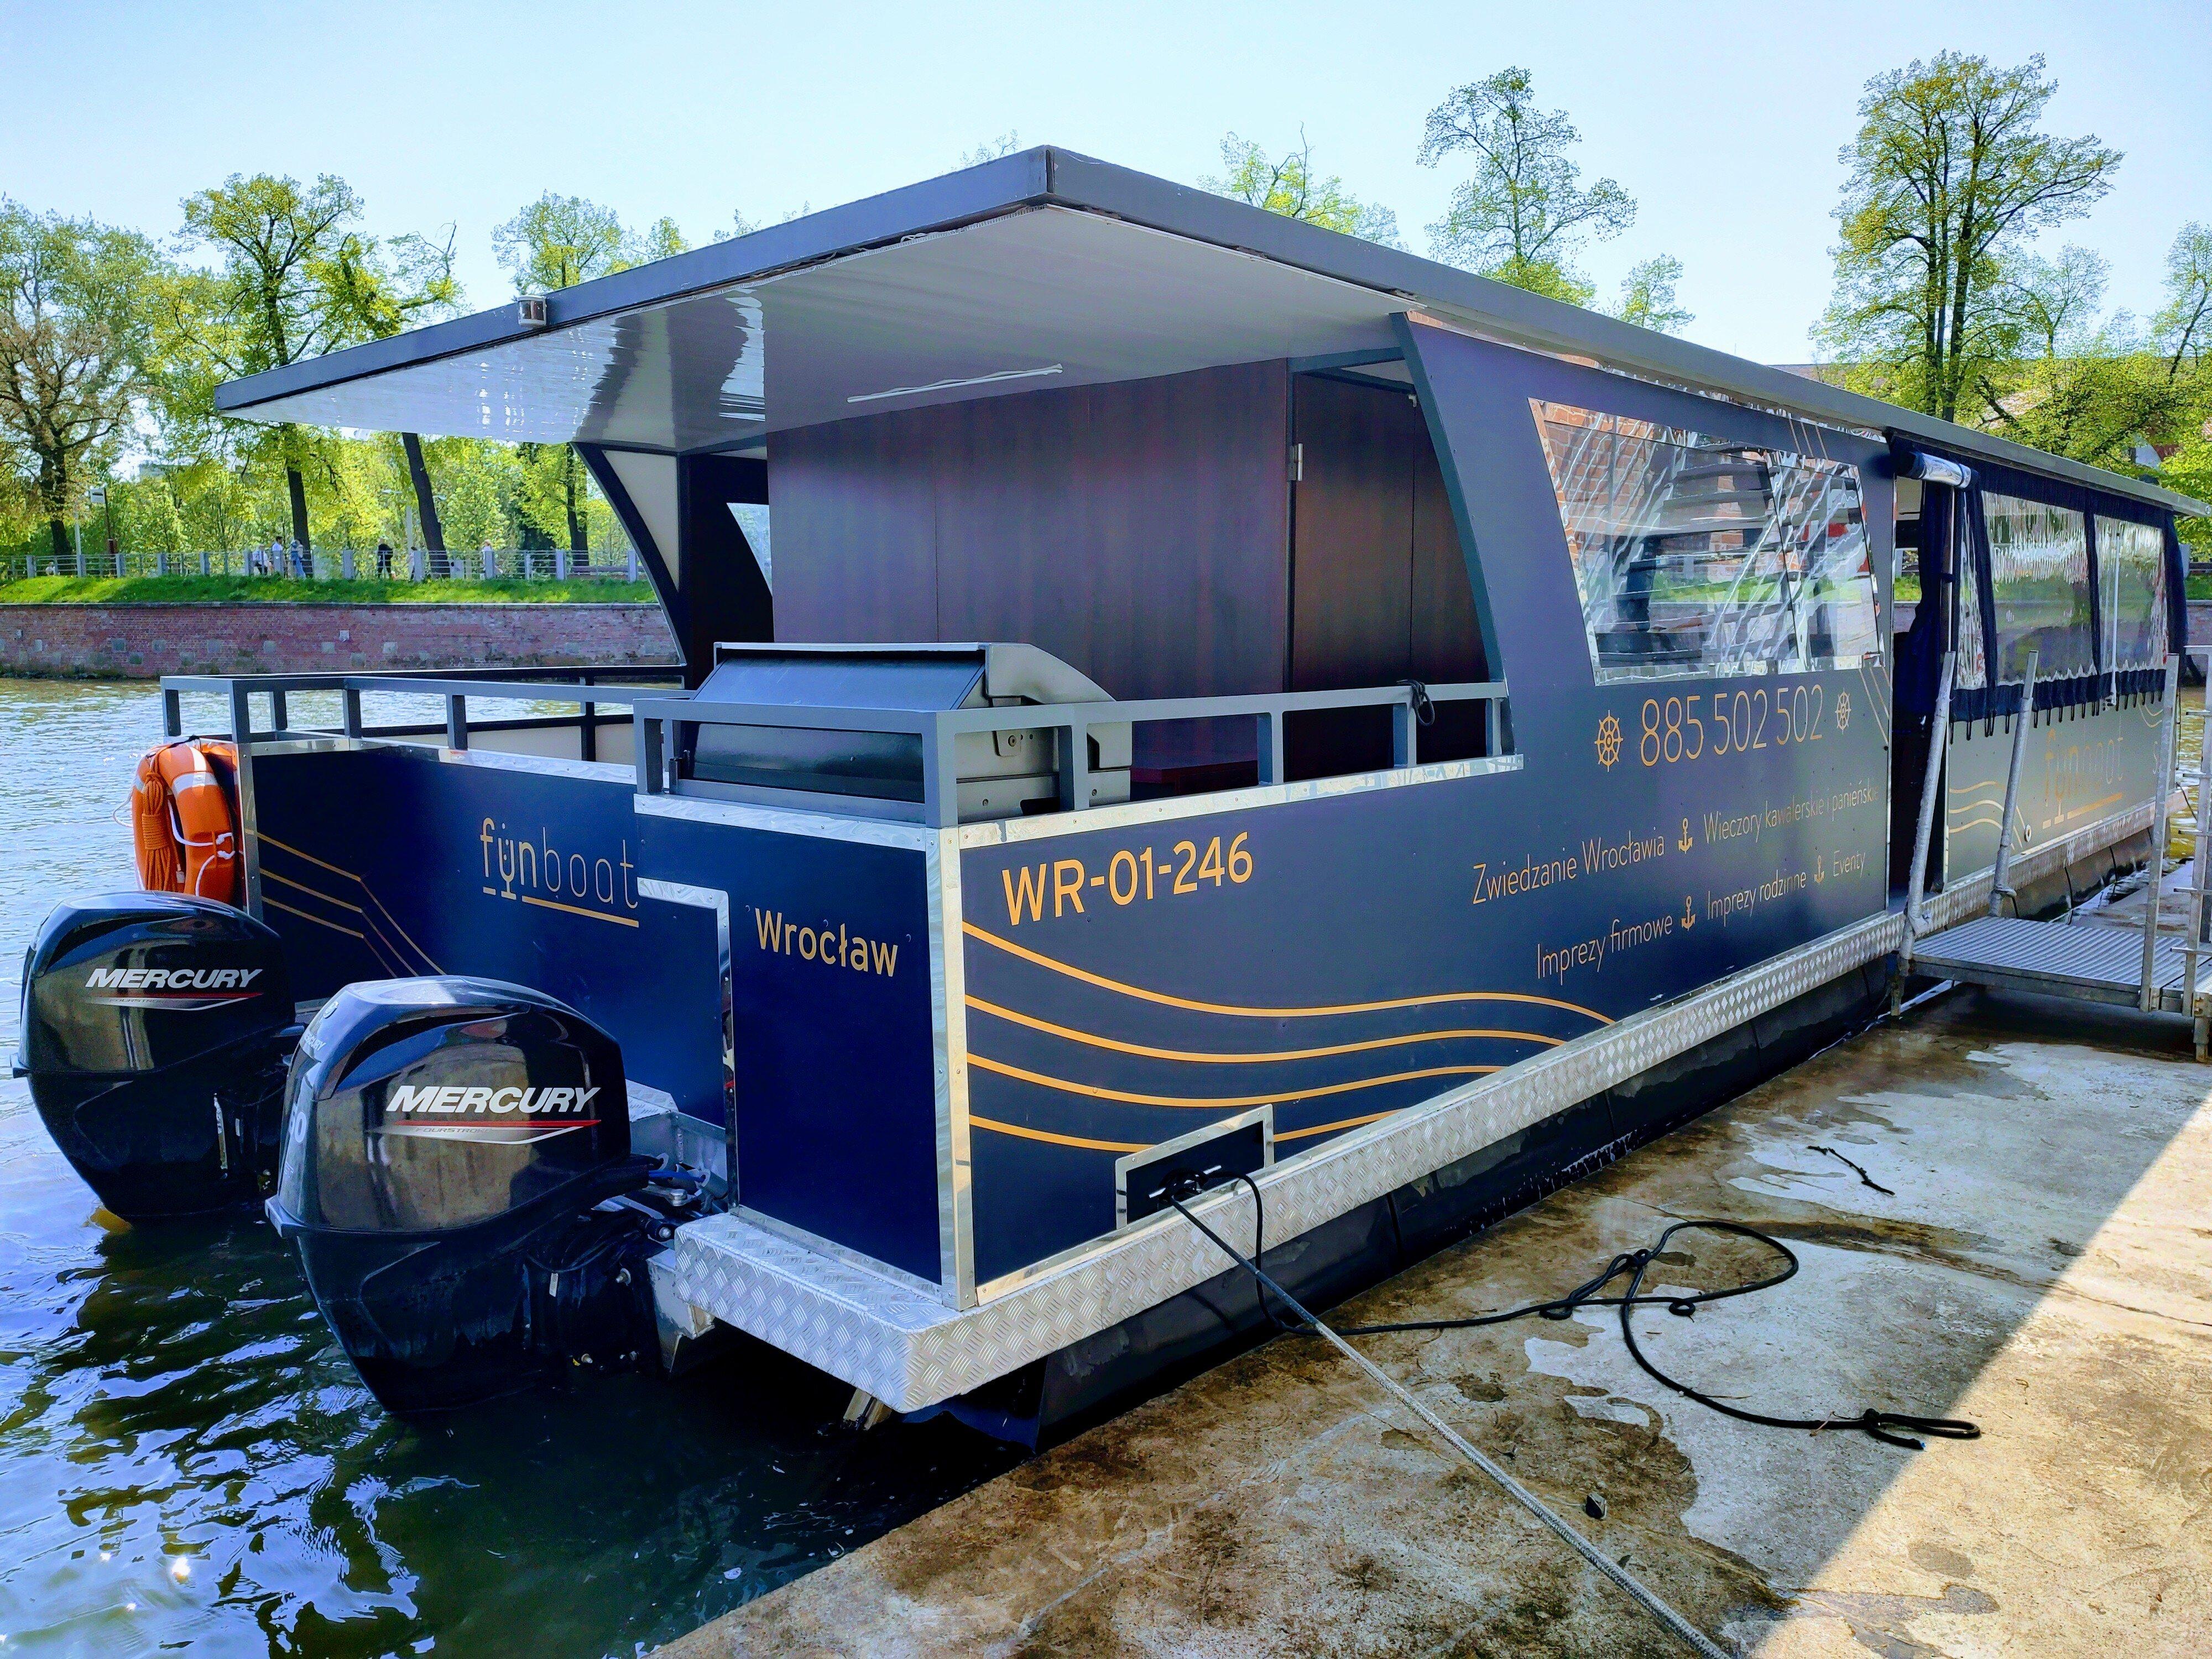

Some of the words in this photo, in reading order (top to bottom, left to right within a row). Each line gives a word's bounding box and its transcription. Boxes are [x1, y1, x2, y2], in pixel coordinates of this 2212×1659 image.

[1640, 695, 1704, 766] 885
[1714, 688, 1767, 755] 502
[1776, 684, 1823, 745] 502
[479, 817, 639, 909] funboat
[1001, 831, 1253, 926] WR-01-246
[1473, 846, 1577, 904] Zwiedzanie
[1582, 826, 1664, 875] Wrocławia
[1703, 811, 1762, 844] Wieczory
[1764, 790, 1825, 828] kawalerskie
[755, 907, 899, 977] Wrocław
[1537, 937, 1606, 986] Imprezy
[1610, 915, 1673, 953] firmowe
[1707, 888, 1757, 927] Imprezy
[1759, 868, 1807, 902] rodzinne
[1832, 849, 1866, 878] Eventy
[85, 968, 263, 988] MERCURY
[386, 1085, 602, 1114] MERCURY
